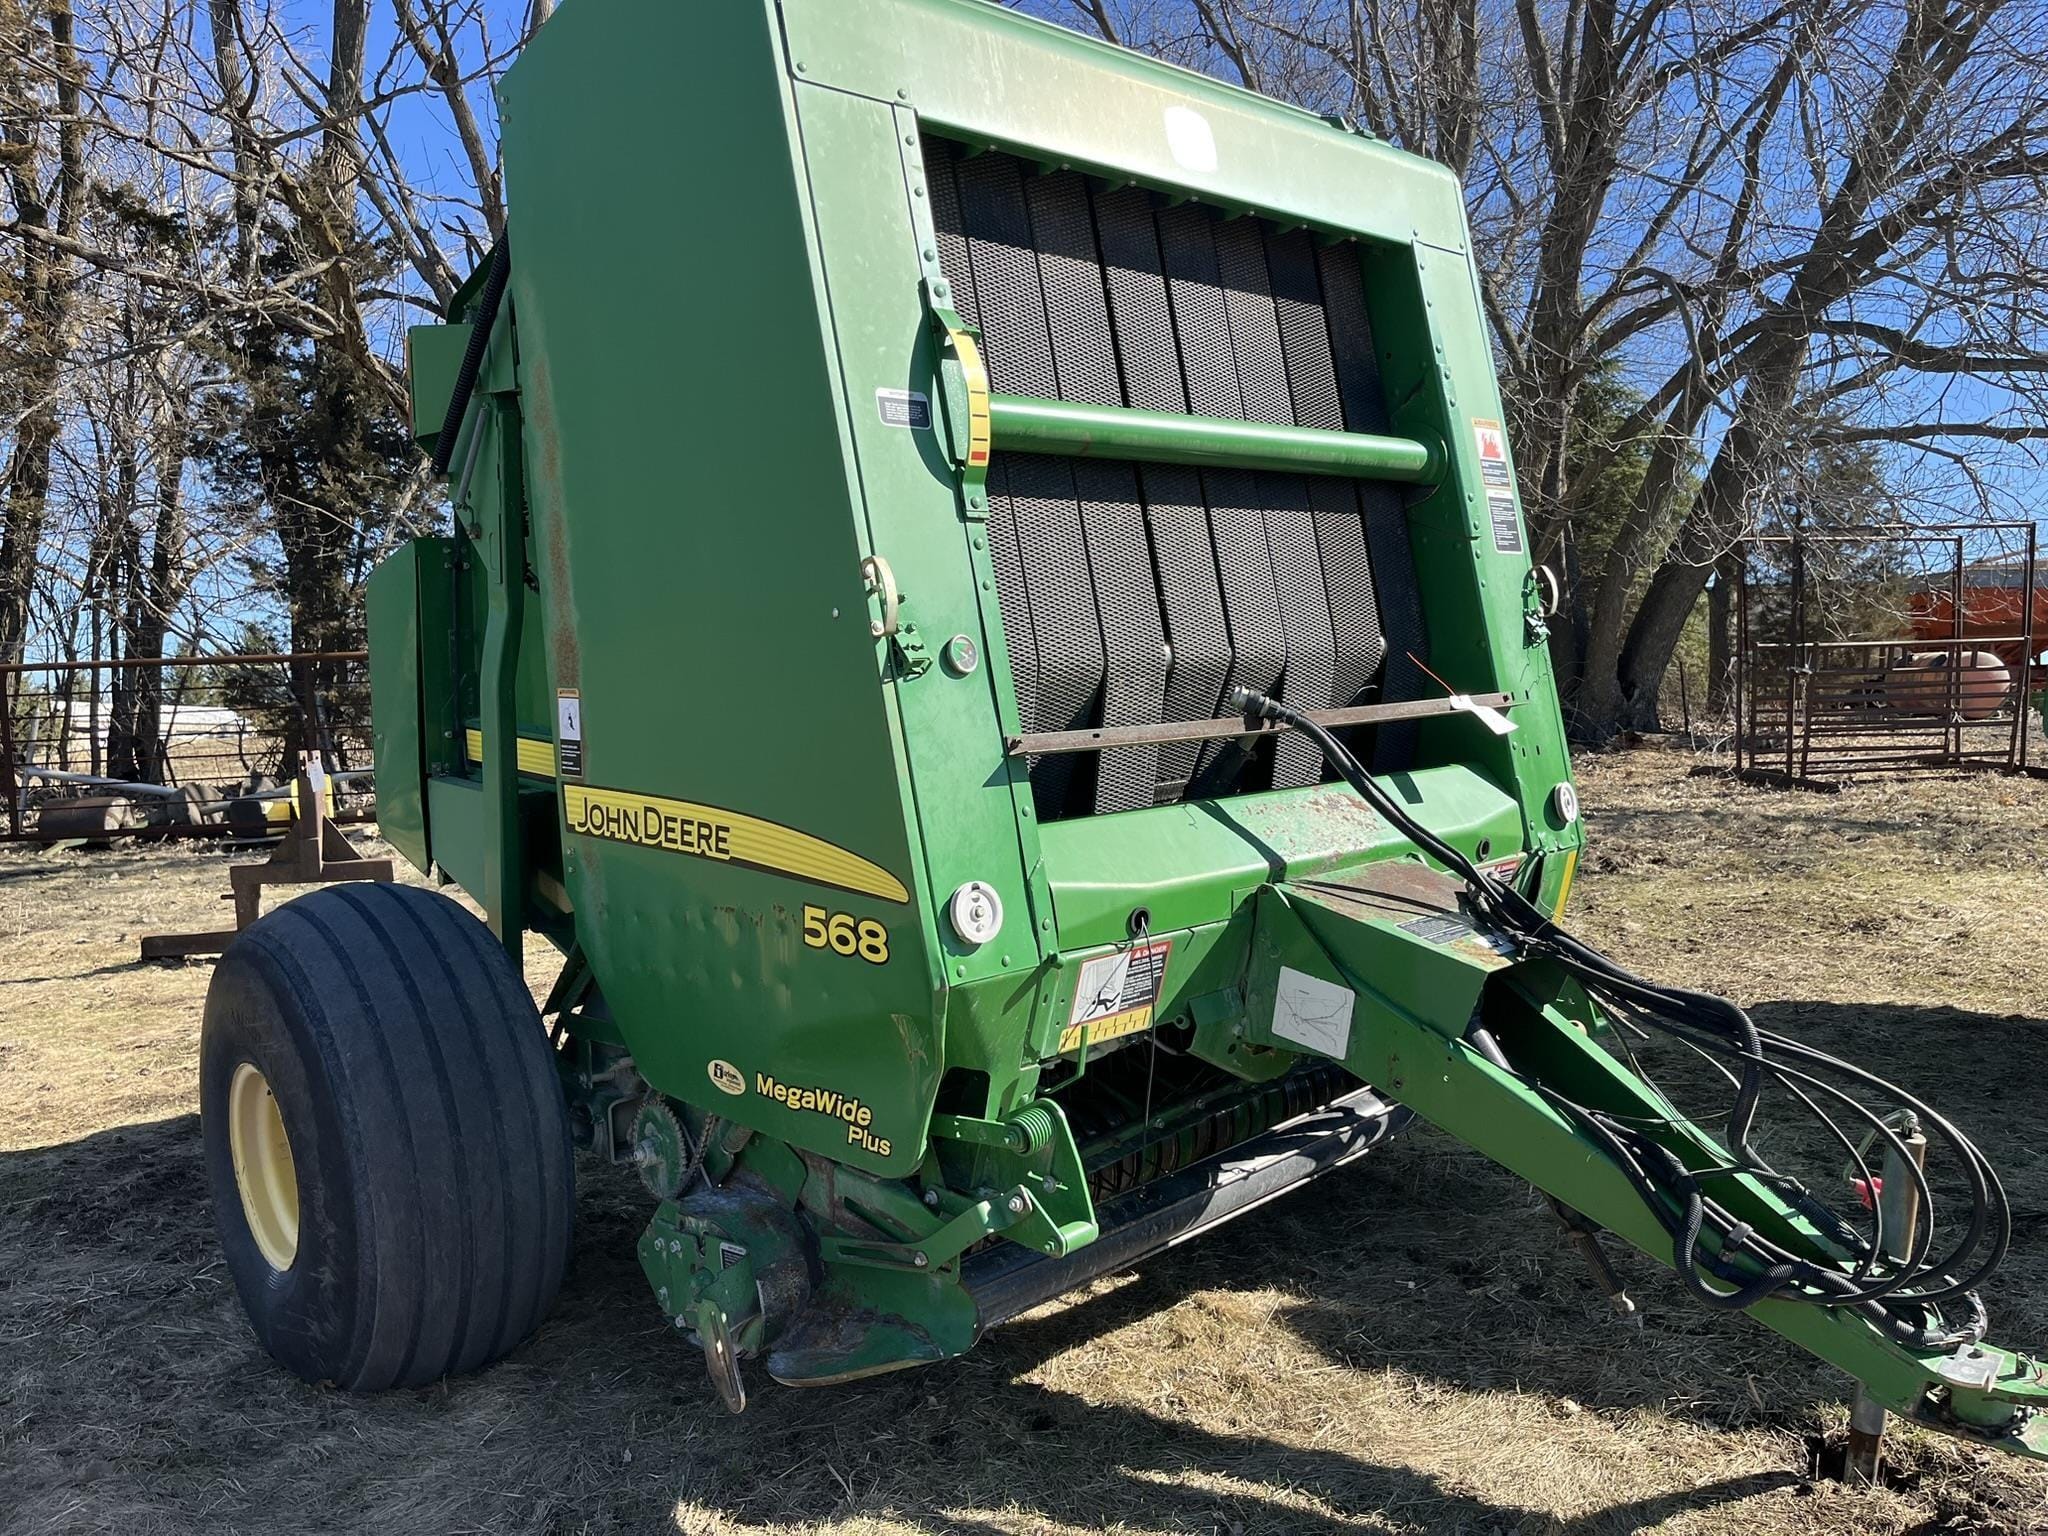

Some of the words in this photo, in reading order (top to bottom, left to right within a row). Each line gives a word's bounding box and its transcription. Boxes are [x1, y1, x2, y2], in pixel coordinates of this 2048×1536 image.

[577, 797, 640, 838] JOHN
[642, 806, 731, 855] DEERE
[803, 904, 889, 964] 568
[756, 1072, 872, 1126] MegaWide
[848, 1125, 892, 1156] Plus
